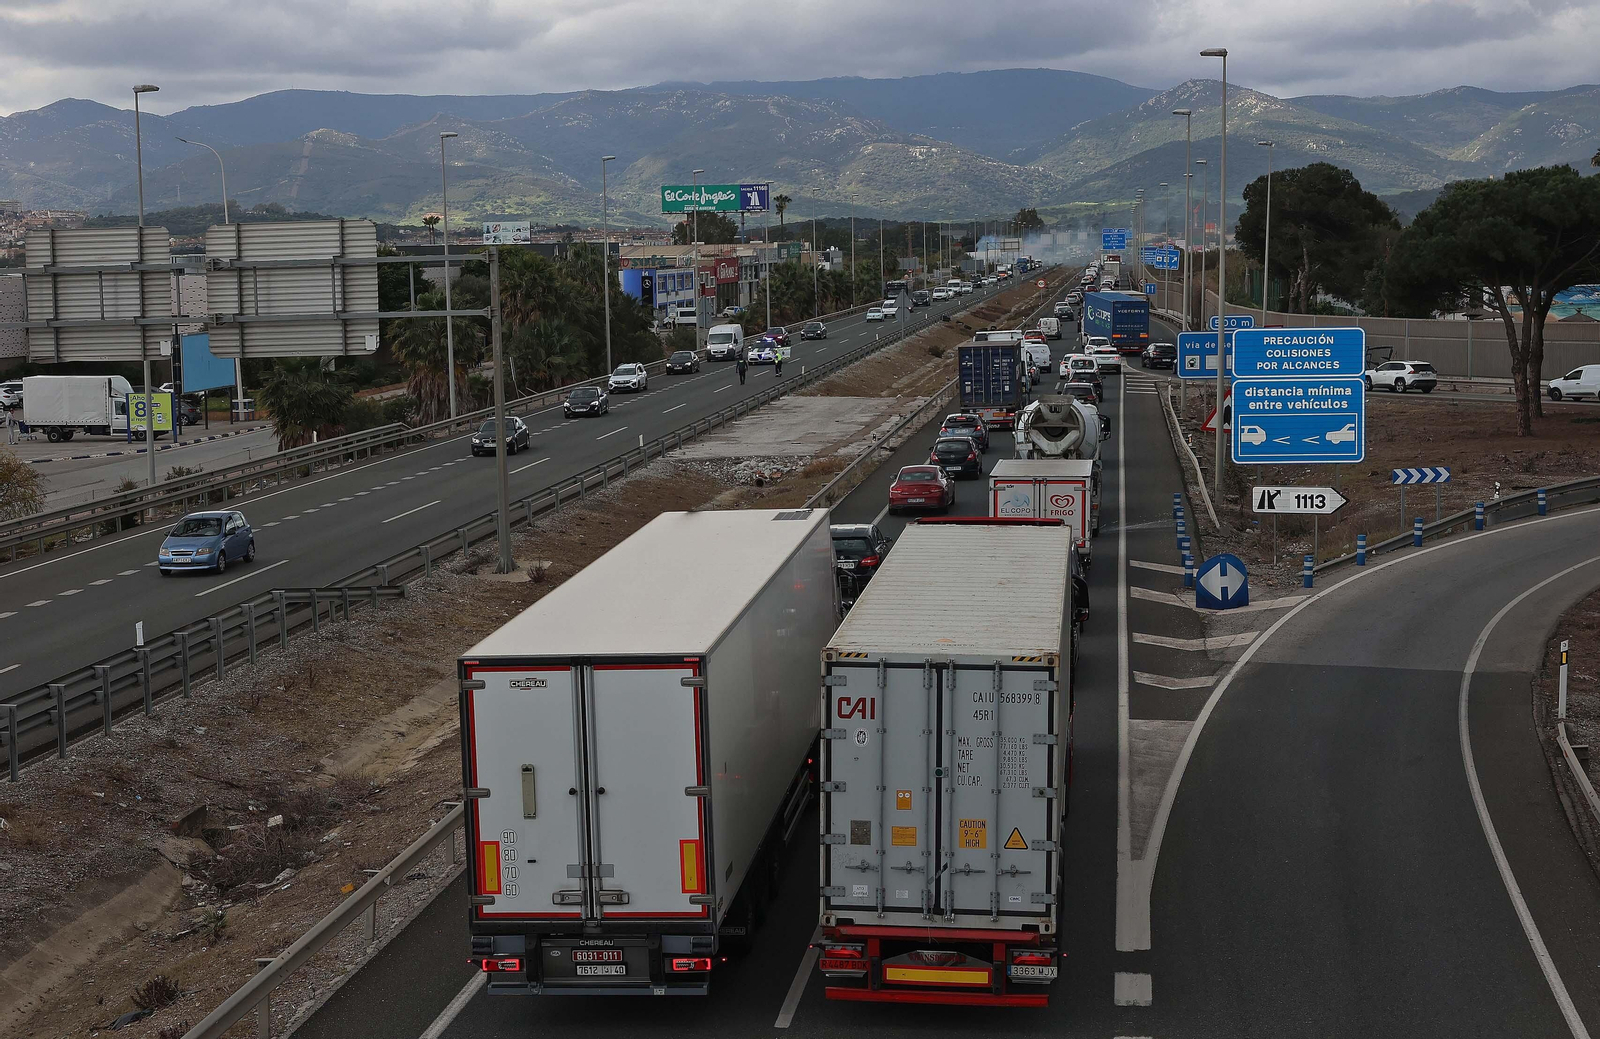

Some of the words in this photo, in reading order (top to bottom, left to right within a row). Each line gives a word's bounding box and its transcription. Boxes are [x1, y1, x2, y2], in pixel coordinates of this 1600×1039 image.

[664, 190, 675, 202] El
[700, 187, 736, 205] Inglés
[1263, 334, 1334, 345] PRECAUCIÓN
[1266, 349, 1331, 358] COLISIONES
[1257, 362, 1278, 370] POR
[1282, 361, 1340, 369] ALCANCES
[1245, 387, 1303, 397] distancia
[1308, 385, 1352, 396] mínima
[1249, 400, 1282, 410] entre
[1287, 398, 1348, 409] vehículos
[1294, 494, 1326, 509] 1113
[972, 692, 994, 703] CAIU
[1000, 693, 1032, 704] 568399
[837, 696, 876, 720] CAI
[972, 710, 994, 720] 45R1
[976, 737, 994, 748] GROSS
[958, 750, 973, 760] TARE
[958, 762, 970, 773] NET
[960, 820, 986, 828] CAUTION
[503, 832, 515, 844] 90
[966, 839, 980, 848] HIGH
[504, 849, 516, 861] 80
[505, 867, 517, 878] 70
[506, 884, 517, 896] 60
[577, 952, 618, 960] 6031-011
[1013, 967, 1035, 976] 3363
